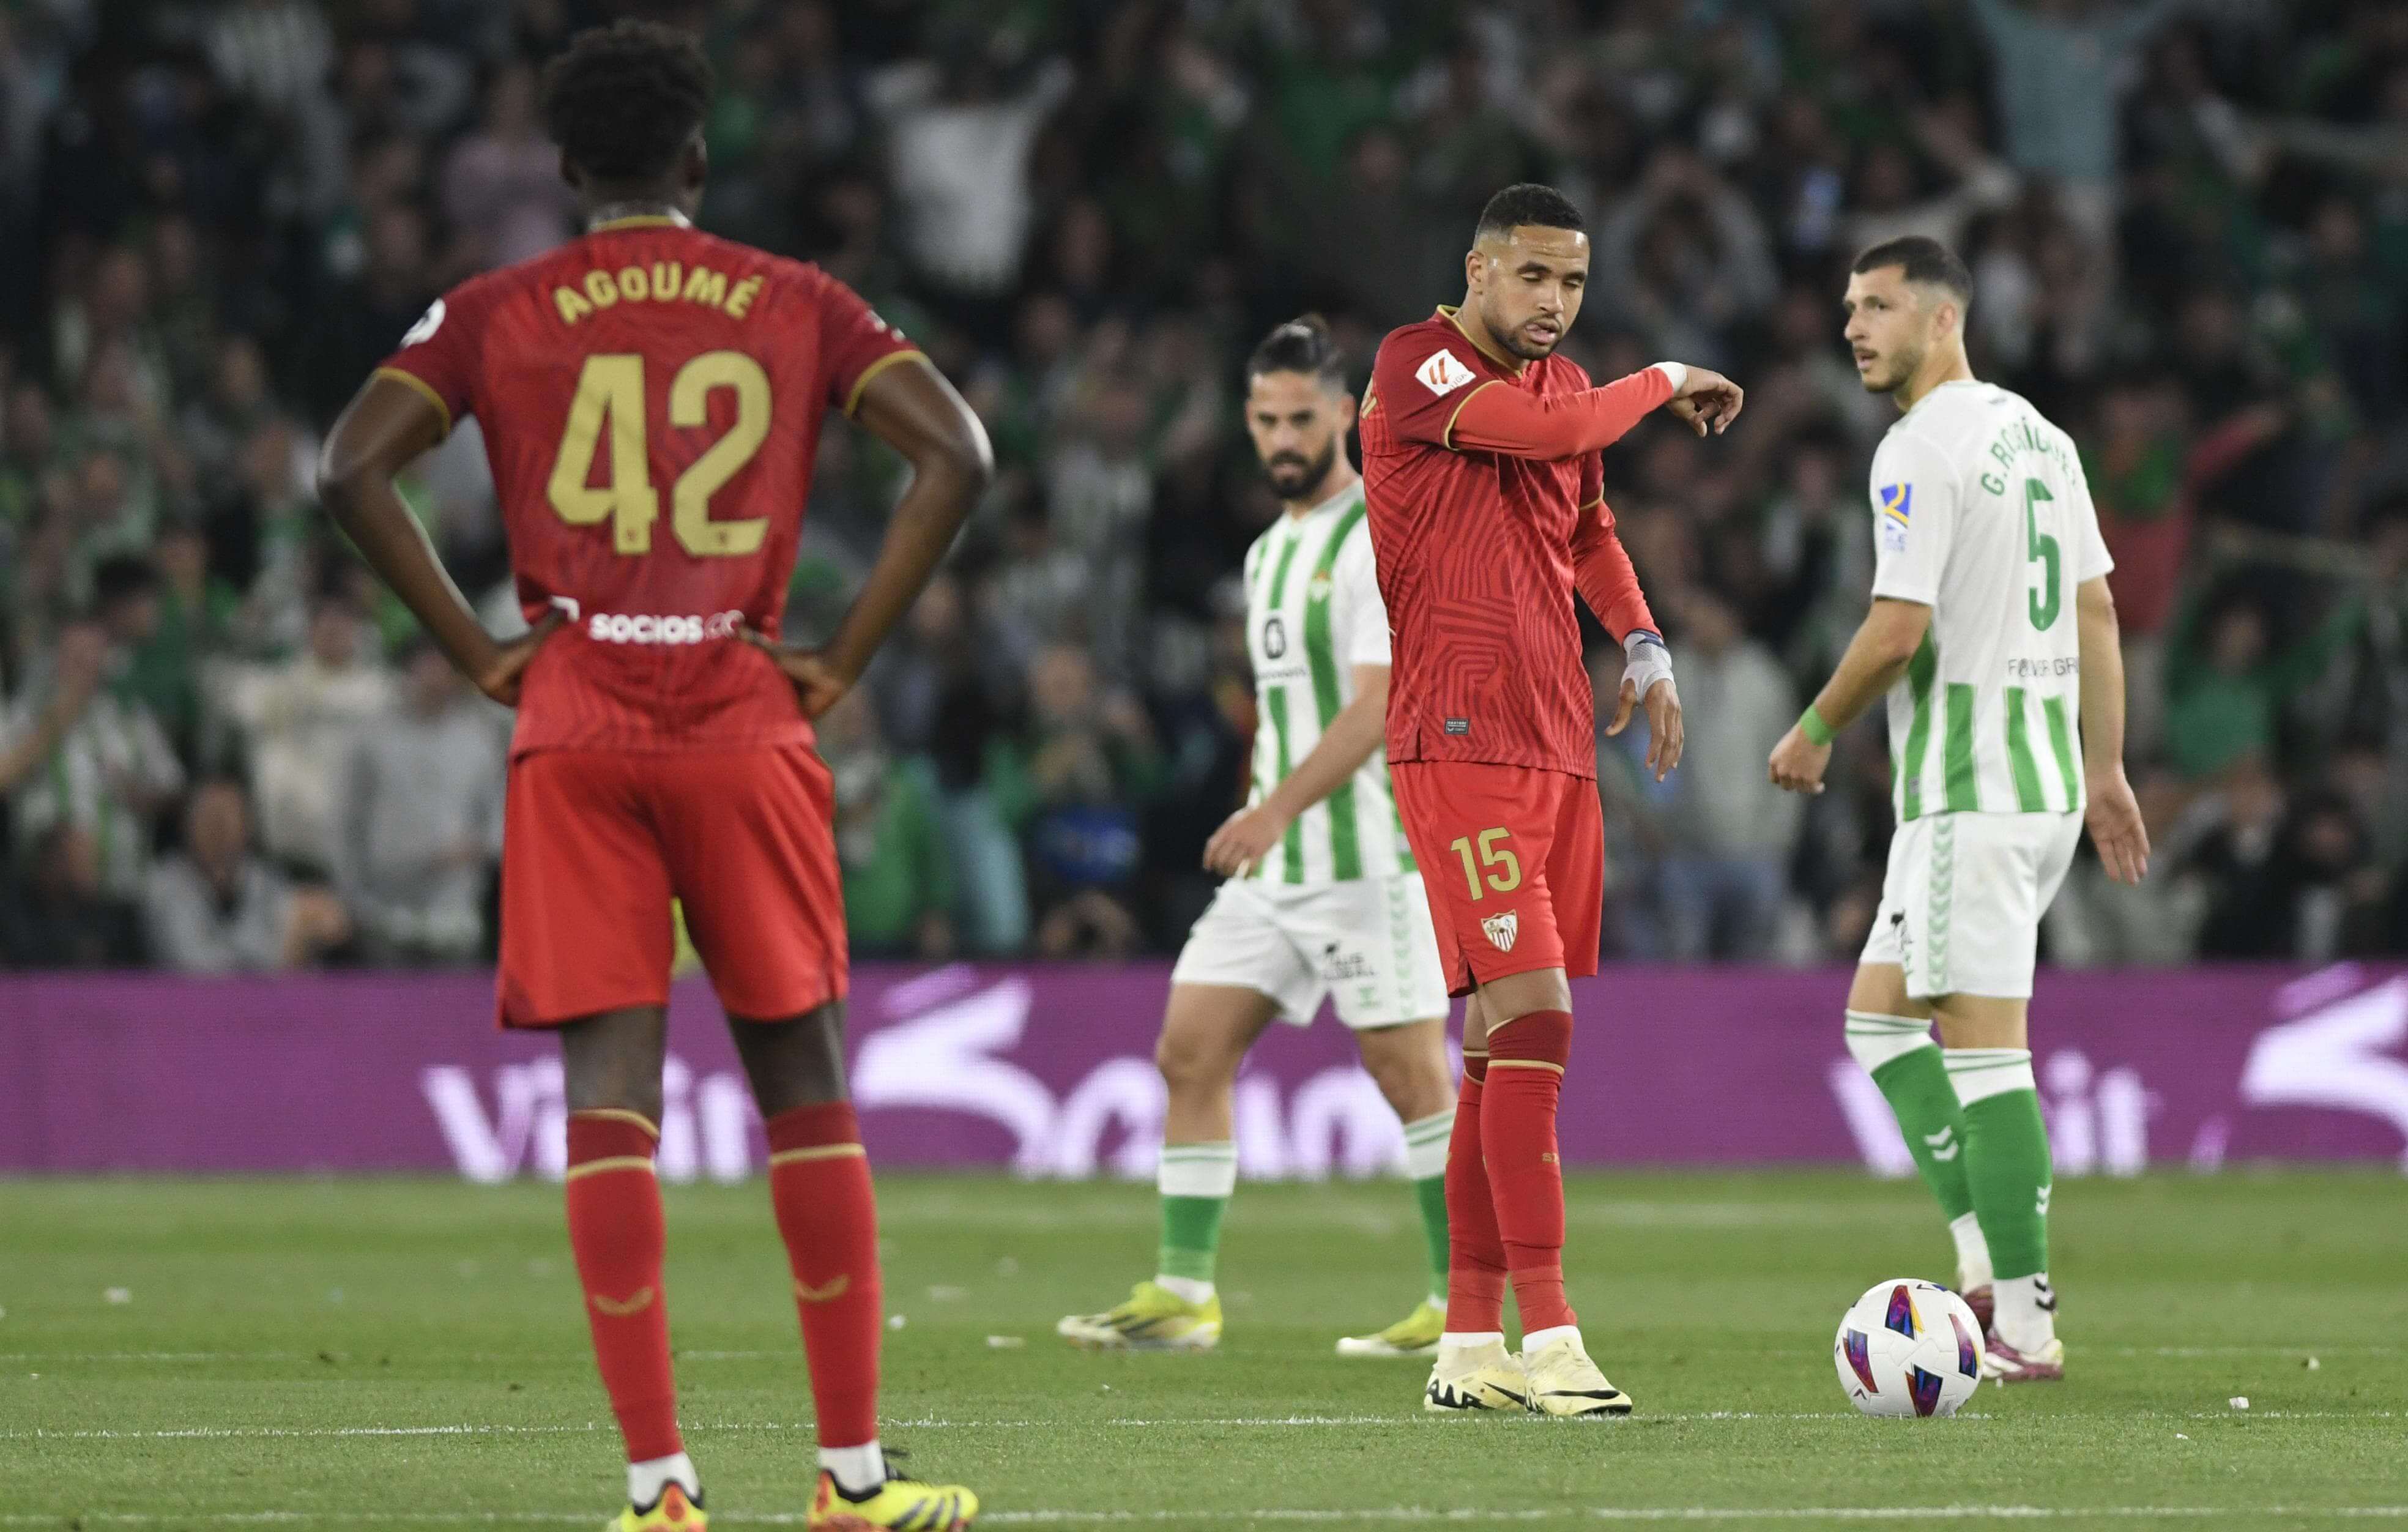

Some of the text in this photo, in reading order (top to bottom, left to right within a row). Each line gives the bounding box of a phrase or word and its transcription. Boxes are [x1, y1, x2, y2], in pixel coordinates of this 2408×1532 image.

[554, 261, 764, 324] AGOUMÉ
[546, 350, 772, 556] 42
[2024, 477, 2061, 631] 5
[2053, 656, 2079, 676] GR
[1450, 827, 1522, 901] 15
